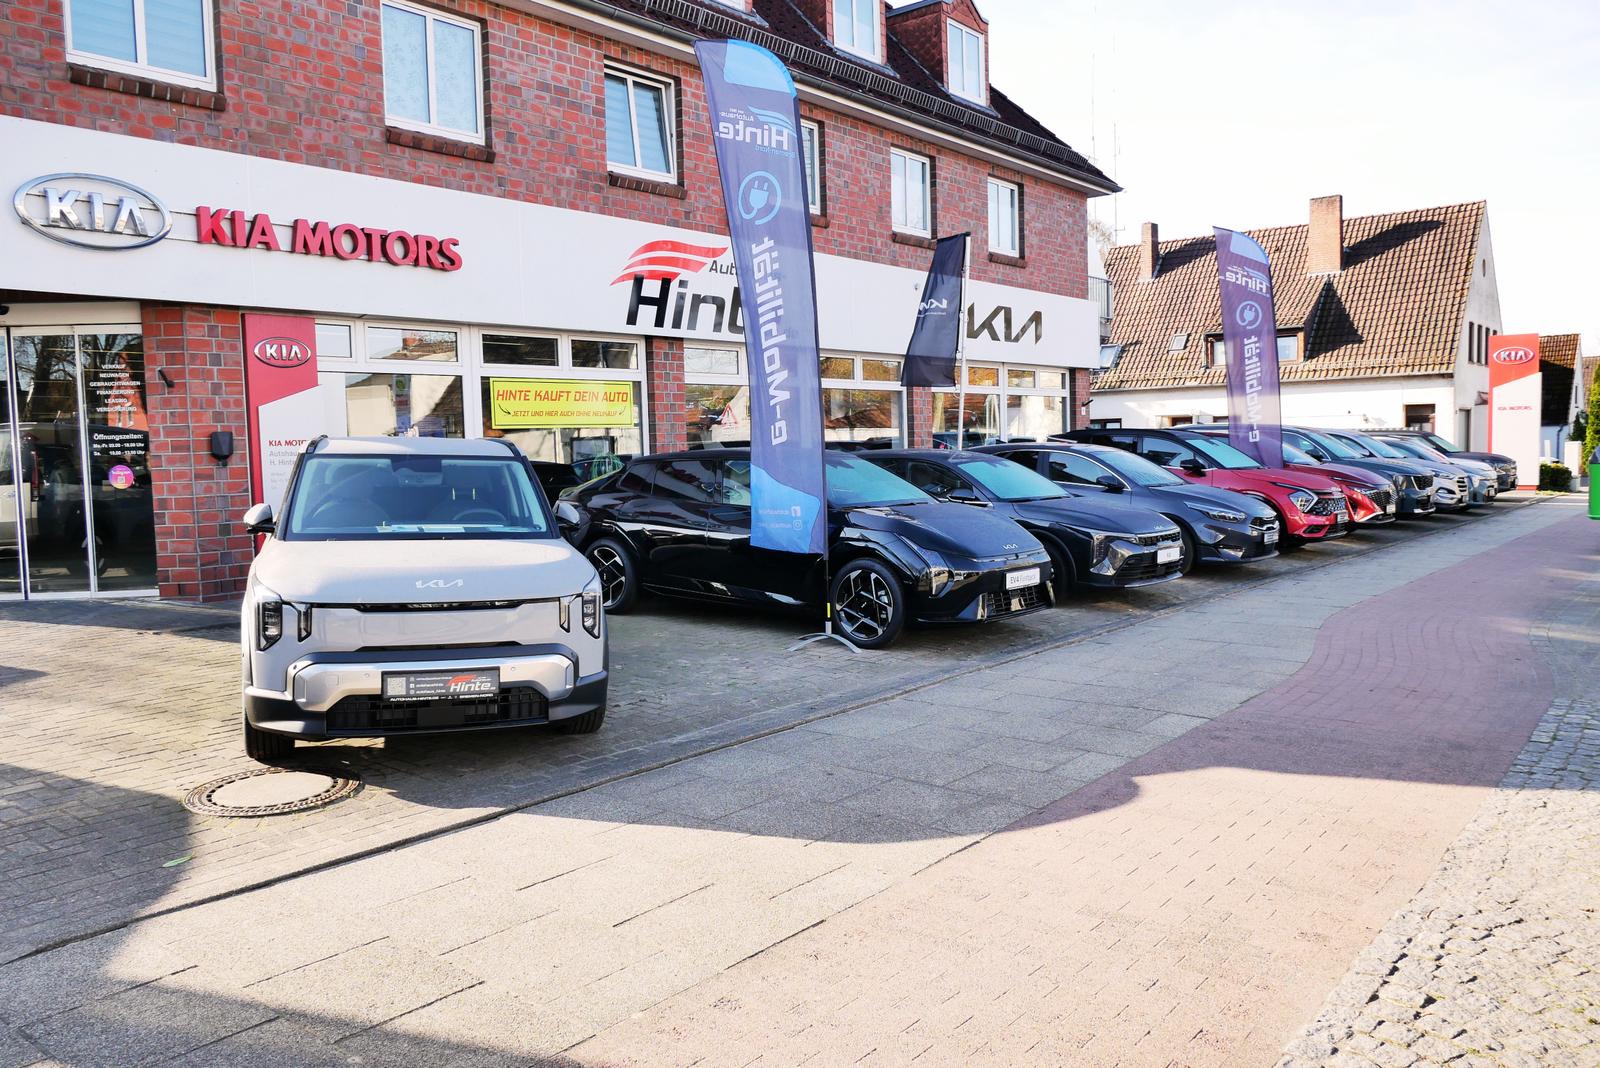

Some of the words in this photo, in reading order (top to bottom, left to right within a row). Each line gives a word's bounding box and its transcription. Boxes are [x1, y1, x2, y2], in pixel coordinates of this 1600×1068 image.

[44, 187, 148, 236] KIA
[196, 206, 281, 251] KIA
[293, 219, 463, 272] MOTORS
[967, 302, 1043, 344] KIA
[265, 343, 302, 360] KIA
[1500, 350, 1527, 361] KIA
[496, 389, 531, 401] HINTE
[534, 390, 572, 401] KAUFT
[574, 391, 599, 401] DEIN
[602, 392, 628, 402] AUTO
[93, 433, 144, 441] Öffnungszeiten:
[416, 579, 464, 588] KIA
